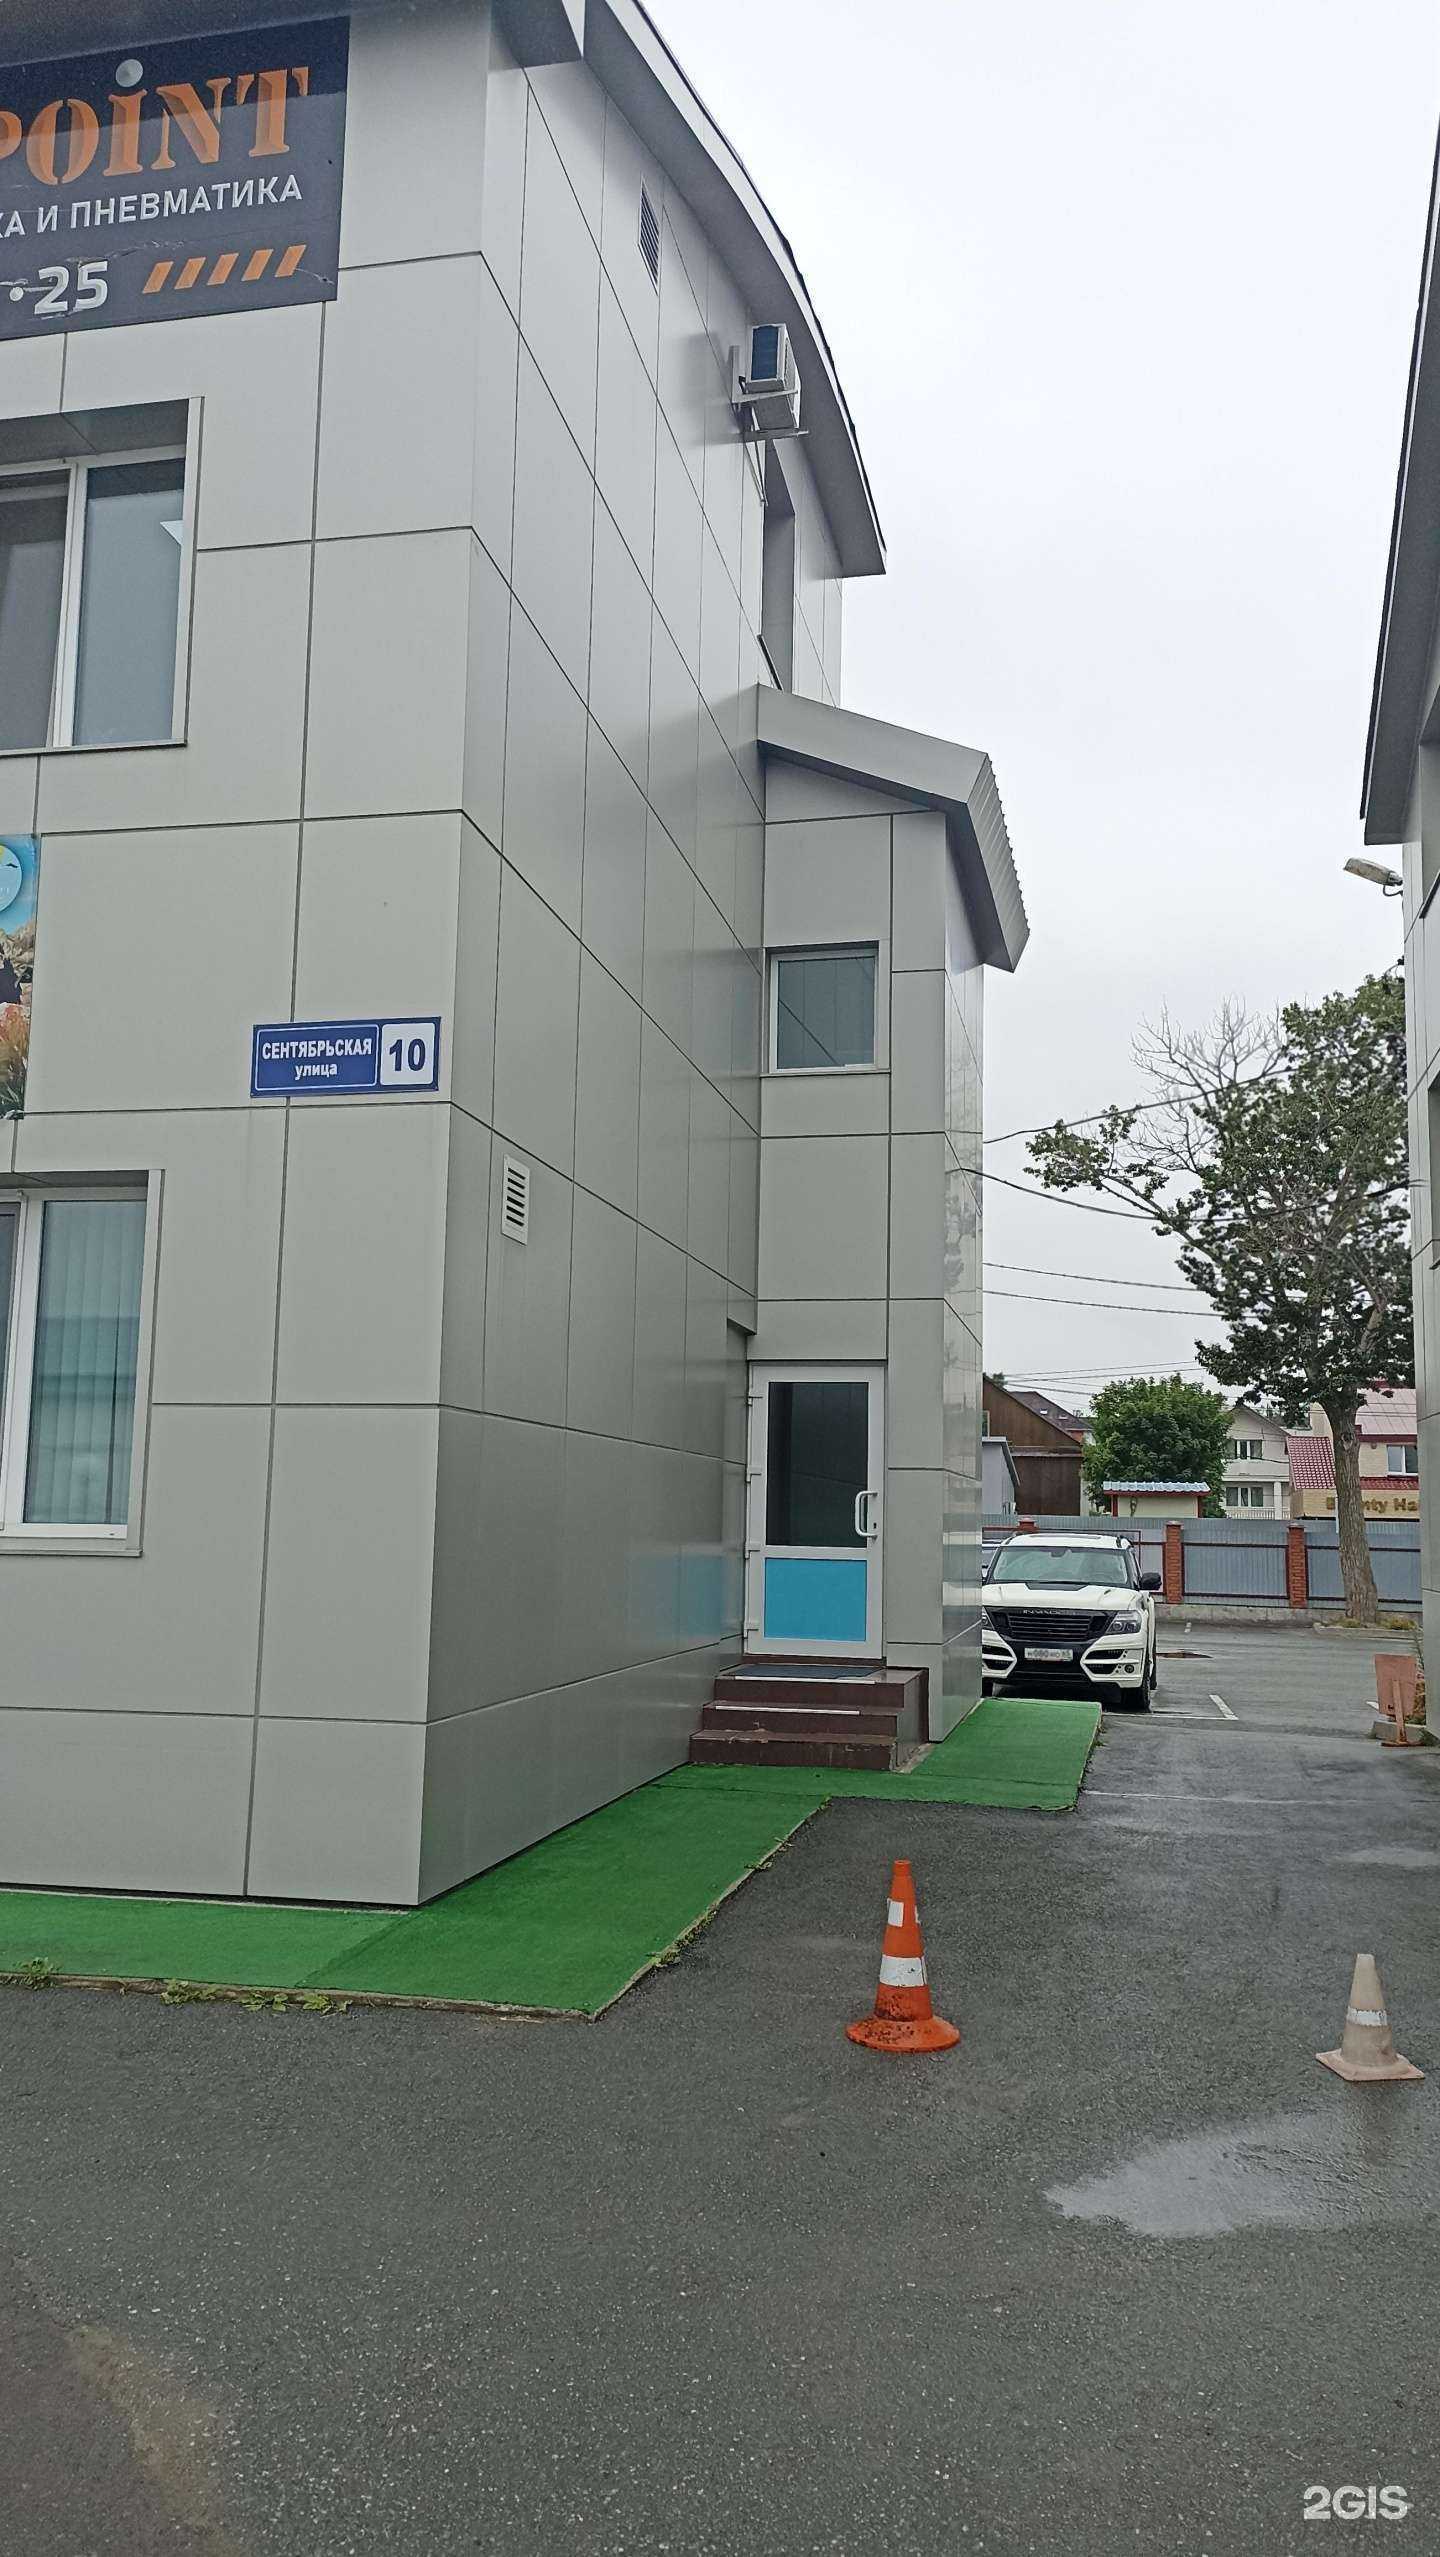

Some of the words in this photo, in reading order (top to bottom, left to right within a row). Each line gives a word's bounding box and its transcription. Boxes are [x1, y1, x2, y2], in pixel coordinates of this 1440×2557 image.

[0, 210, 26, 238] А
[37, 205, 59, 233] И
[70, 174, 303, 229] ПНЕВМАТИКА
[262, 1038, 372, 1060] СЕНТЯБРЬСКАЯ
[389, 1038, 426, 1072] 10
[294, 1063, 338, 1080] улица
